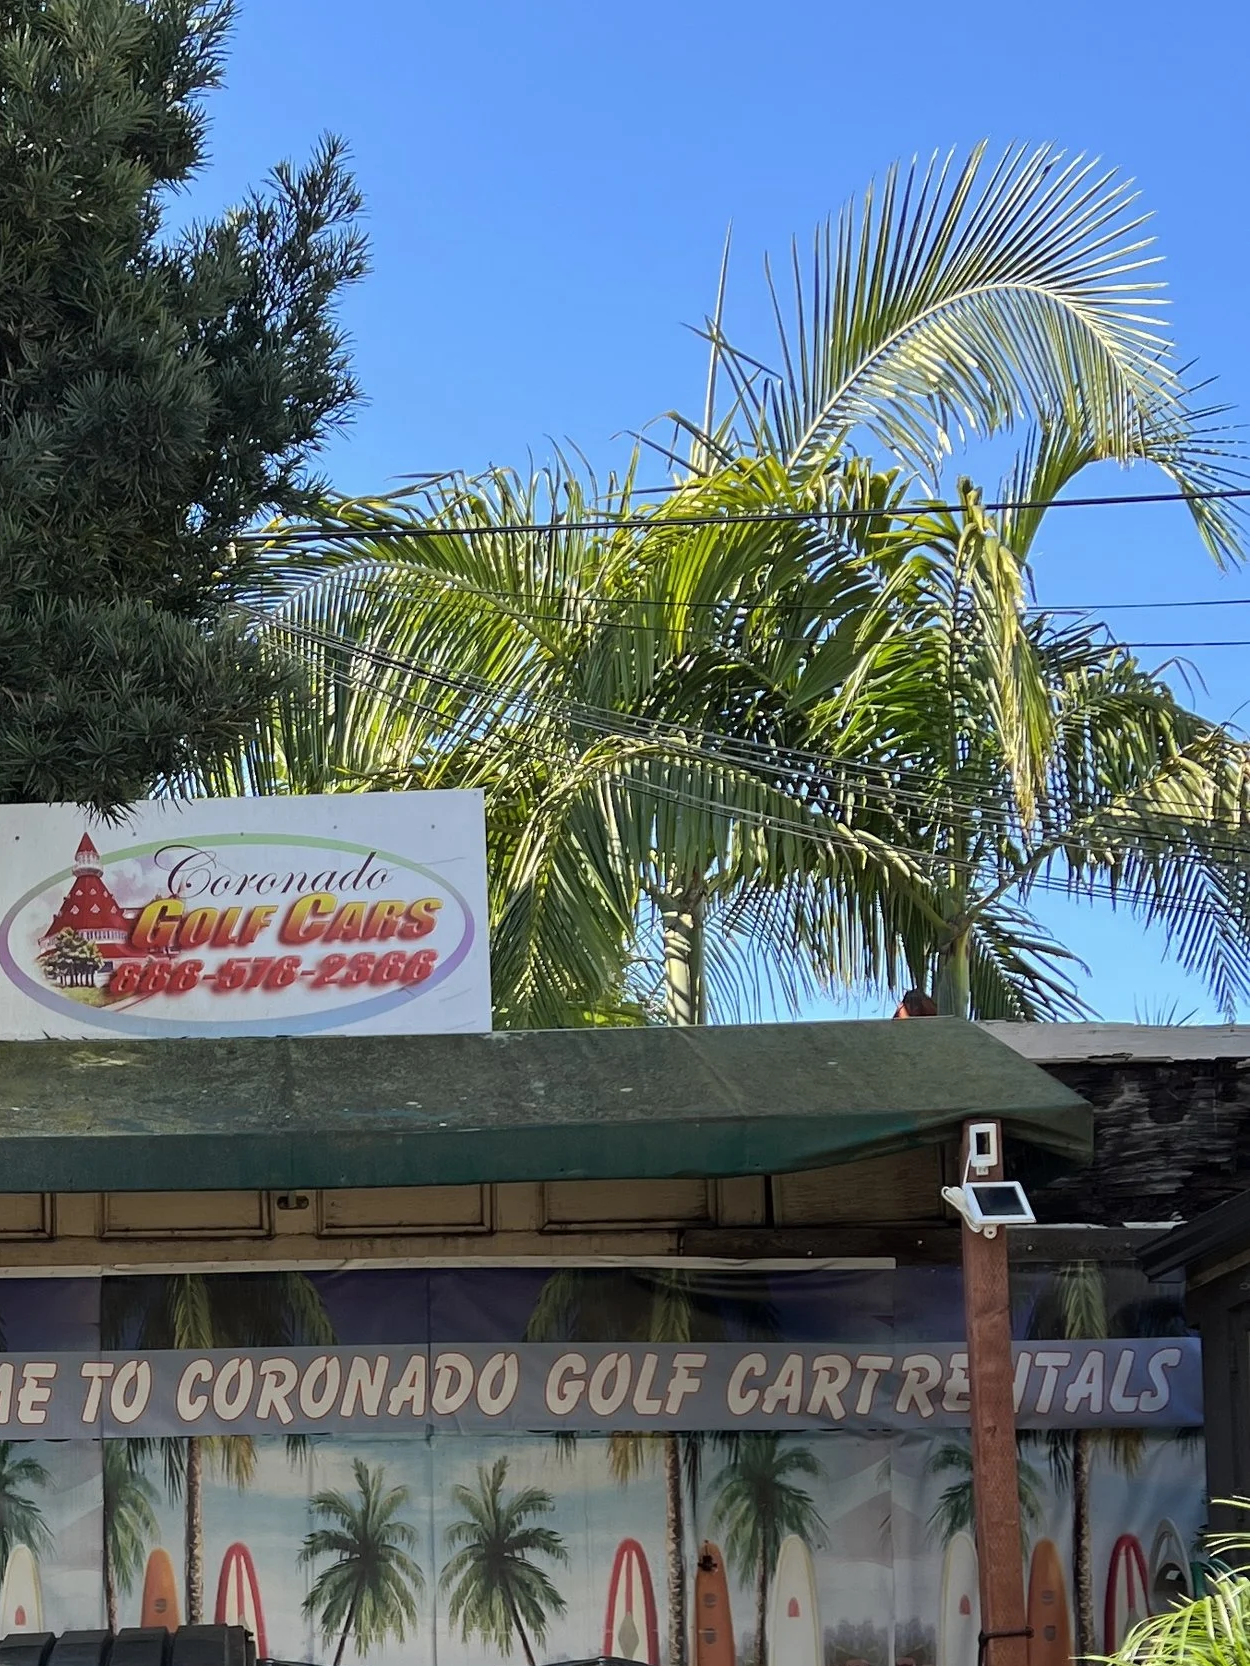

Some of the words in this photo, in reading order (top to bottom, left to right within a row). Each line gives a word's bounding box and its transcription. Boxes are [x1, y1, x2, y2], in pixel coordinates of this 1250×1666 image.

[153, 845, 395, 899] Coronado
[130, 899, 278, 950] GOLF
[282, 893, 444, 946] CARS
[80, 1359, 152, 1425] TO
[176, 1352, 520, 1426] CORONADO
[544, 1351, 709, 1418] GOLF
[726, 1353, 894, 1421] CART
